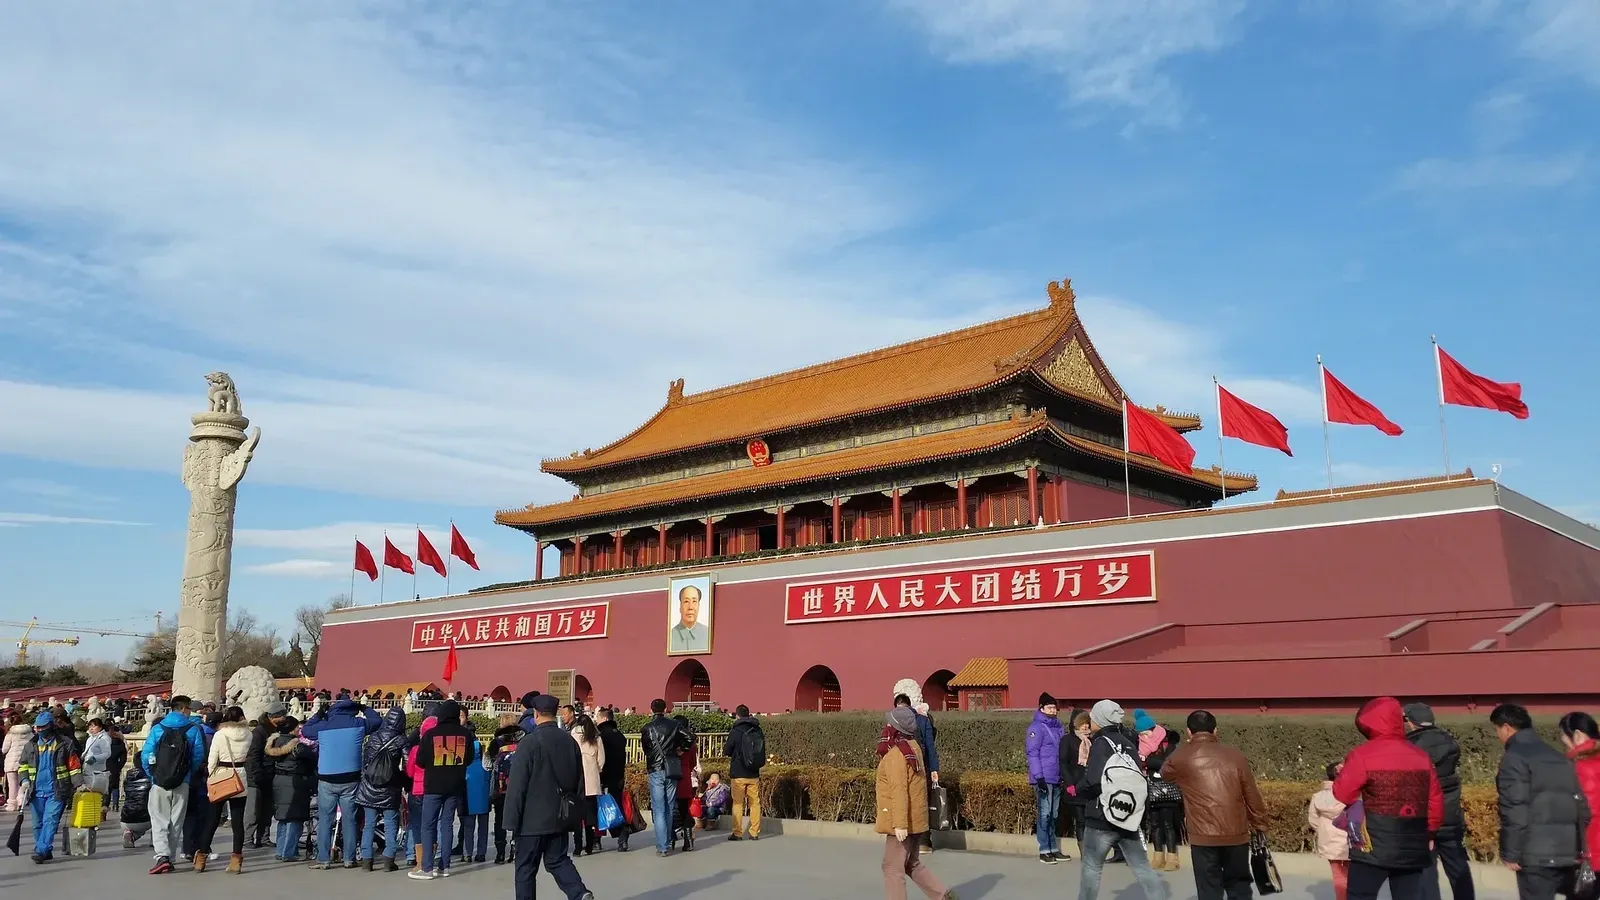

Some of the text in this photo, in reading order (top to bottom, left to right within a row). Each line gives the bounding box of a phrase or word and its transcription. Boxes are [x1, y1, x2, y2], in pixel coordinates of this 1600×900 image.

[802, 562, 1130, 616] 世界人民大团结万岁
[420, 609, 597, 646] 中华人民共和国万岁
